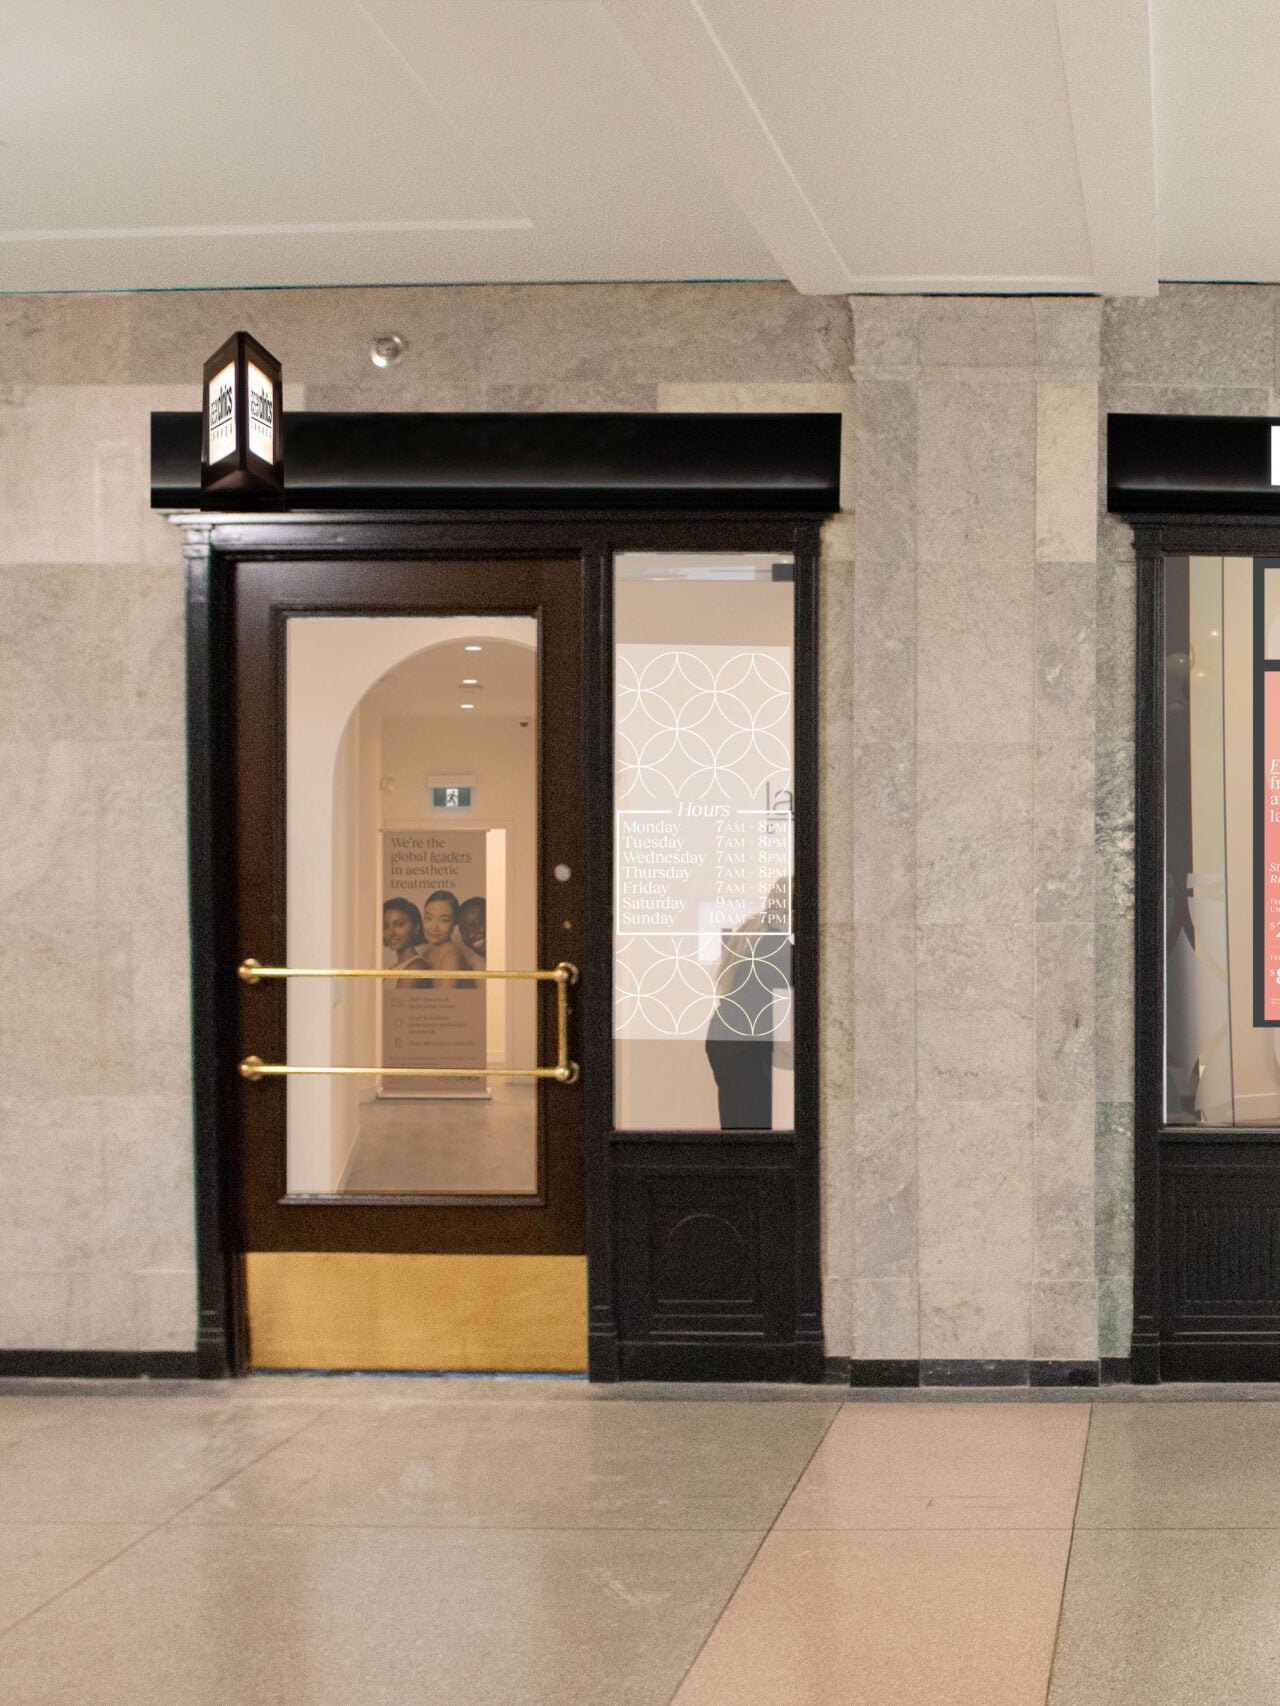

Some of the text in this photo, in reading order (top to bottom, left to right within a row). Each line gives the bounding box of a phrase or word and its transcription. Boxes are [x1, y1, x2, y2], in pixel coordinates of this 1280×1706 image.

[677, 802, 730, 817] Hours
[622, 820, 681, 836] Monday
[391, 837, 446, 849] We're the
[622, 836, 684, 852] Tuesday
[390, 851, 472, 865] global leaders
[622, 851, 706, 867] Wednesday
[390, 864, 460, 875] in aesthetic
[622, 866, 692, 882] Thursday
[390, 878, 456, 889] treatments
[622, 881, 670, 897] Friday
[622, 897, 687, 912] Saturday
[622, 912, 677, 927] Sunday
